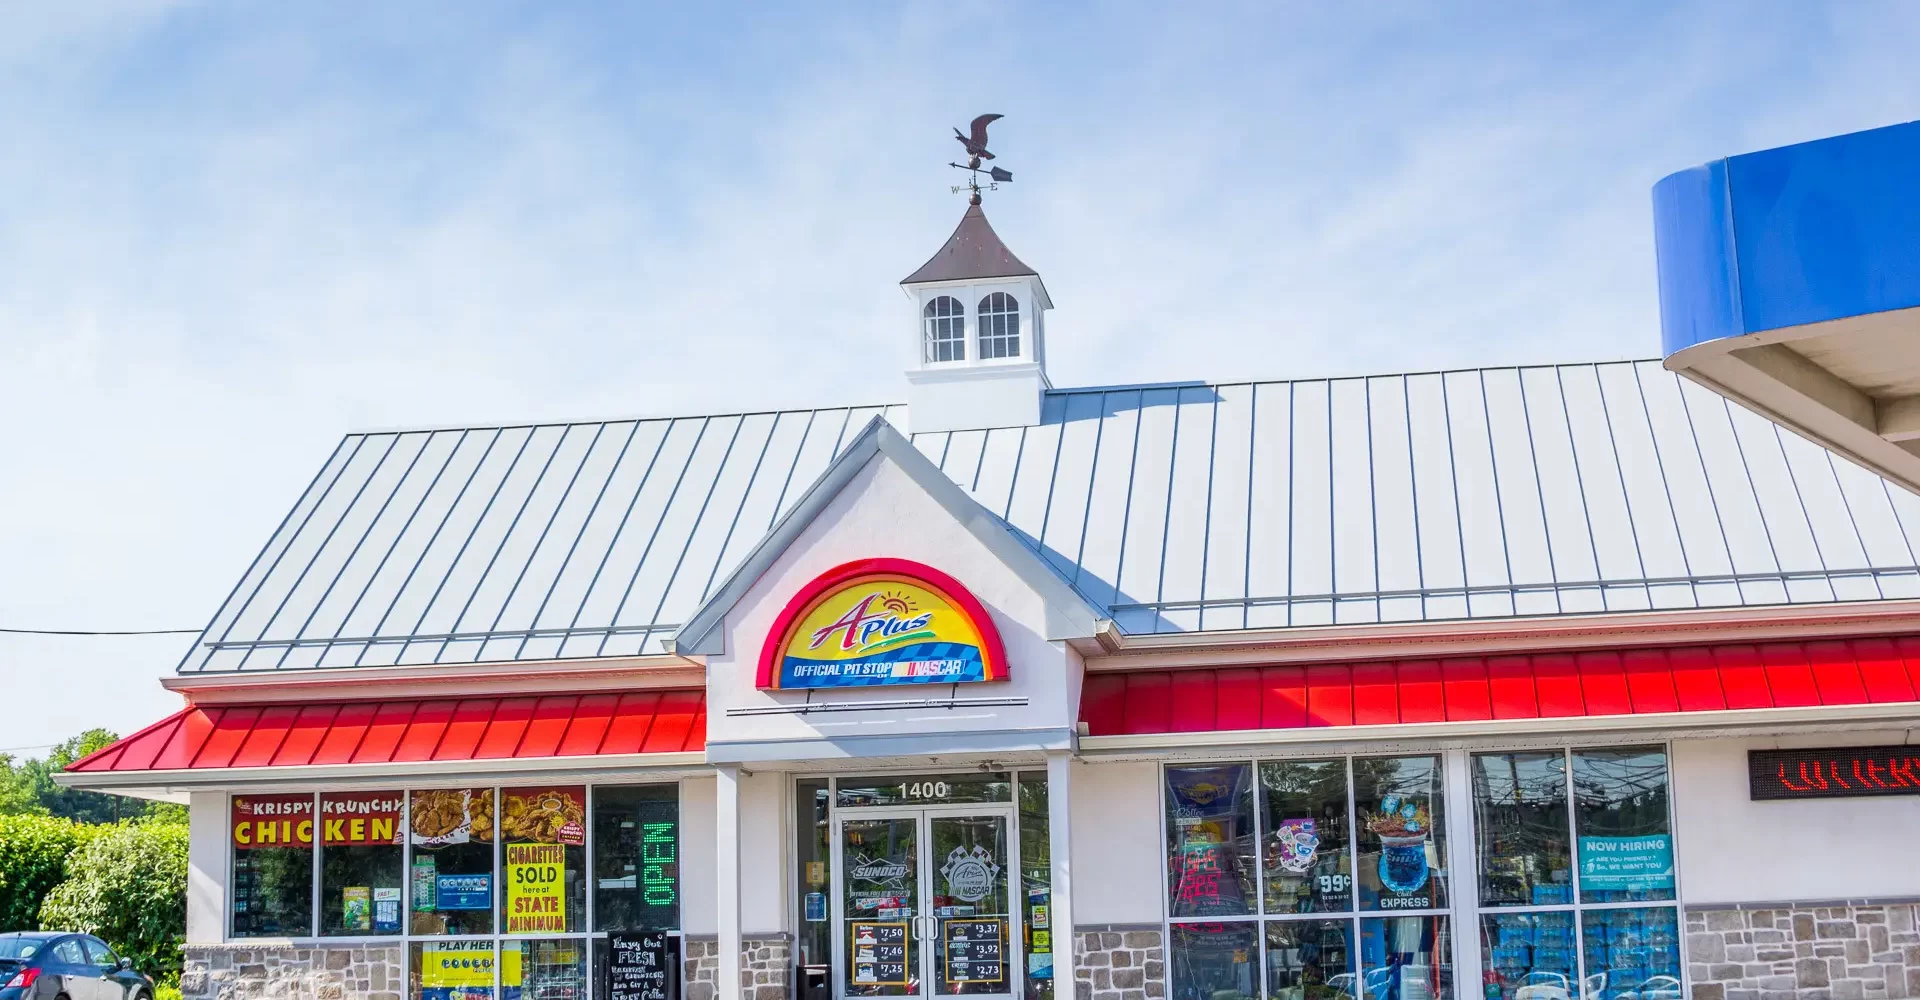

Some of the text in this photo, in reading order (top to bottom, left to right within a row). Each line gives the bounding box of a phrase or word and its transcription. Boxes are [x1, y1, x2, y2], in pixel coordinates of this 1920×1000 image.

[951, 186, 960, 194] W
[990, 183, 998, 191] E
[794, 660, 963, 677] OFFICIAL PIT STOP NASCAR
[898, 781, 947, 799] 1400
[253, 802, 314, 815] KRISPY
[322, 799, 403, 814] KRUNCHY
[234, 818, 393, 844] CHICKEN
[1586, 840, 1665, 852] NOW HIRING
[509, 845, 564, 865] CIGARETTES
[643, 823, 675, 905] OPEN
[516, 866, 557, 884] SOLD
[856, 866, 905, 877] SUNOCO
[522, 885, 540, 893] here
[1319, 875, 1351, 893] 99¢
[962, 886, 990, 895] NASCAR
[515, 897, 558, 913] STATE
[1381, 898, 1429, 908] EXPRESS
[509, 916, 564, 932] MINIMUM
[976, 924, 998, 934] $3.37
[881, 929, 903, 938] $7.50
[438, 941, 494, 950] PLAY HER
[613, 936, 641, 951] Enjoy
[976, 944, 998, 954] $3.92
[881, 946, 903, 956] $7.46
[618, 951, 656, 966] FRESH
[881, 964, 903, 973] $7.25
[976, 965, 999, 975] $2.73
